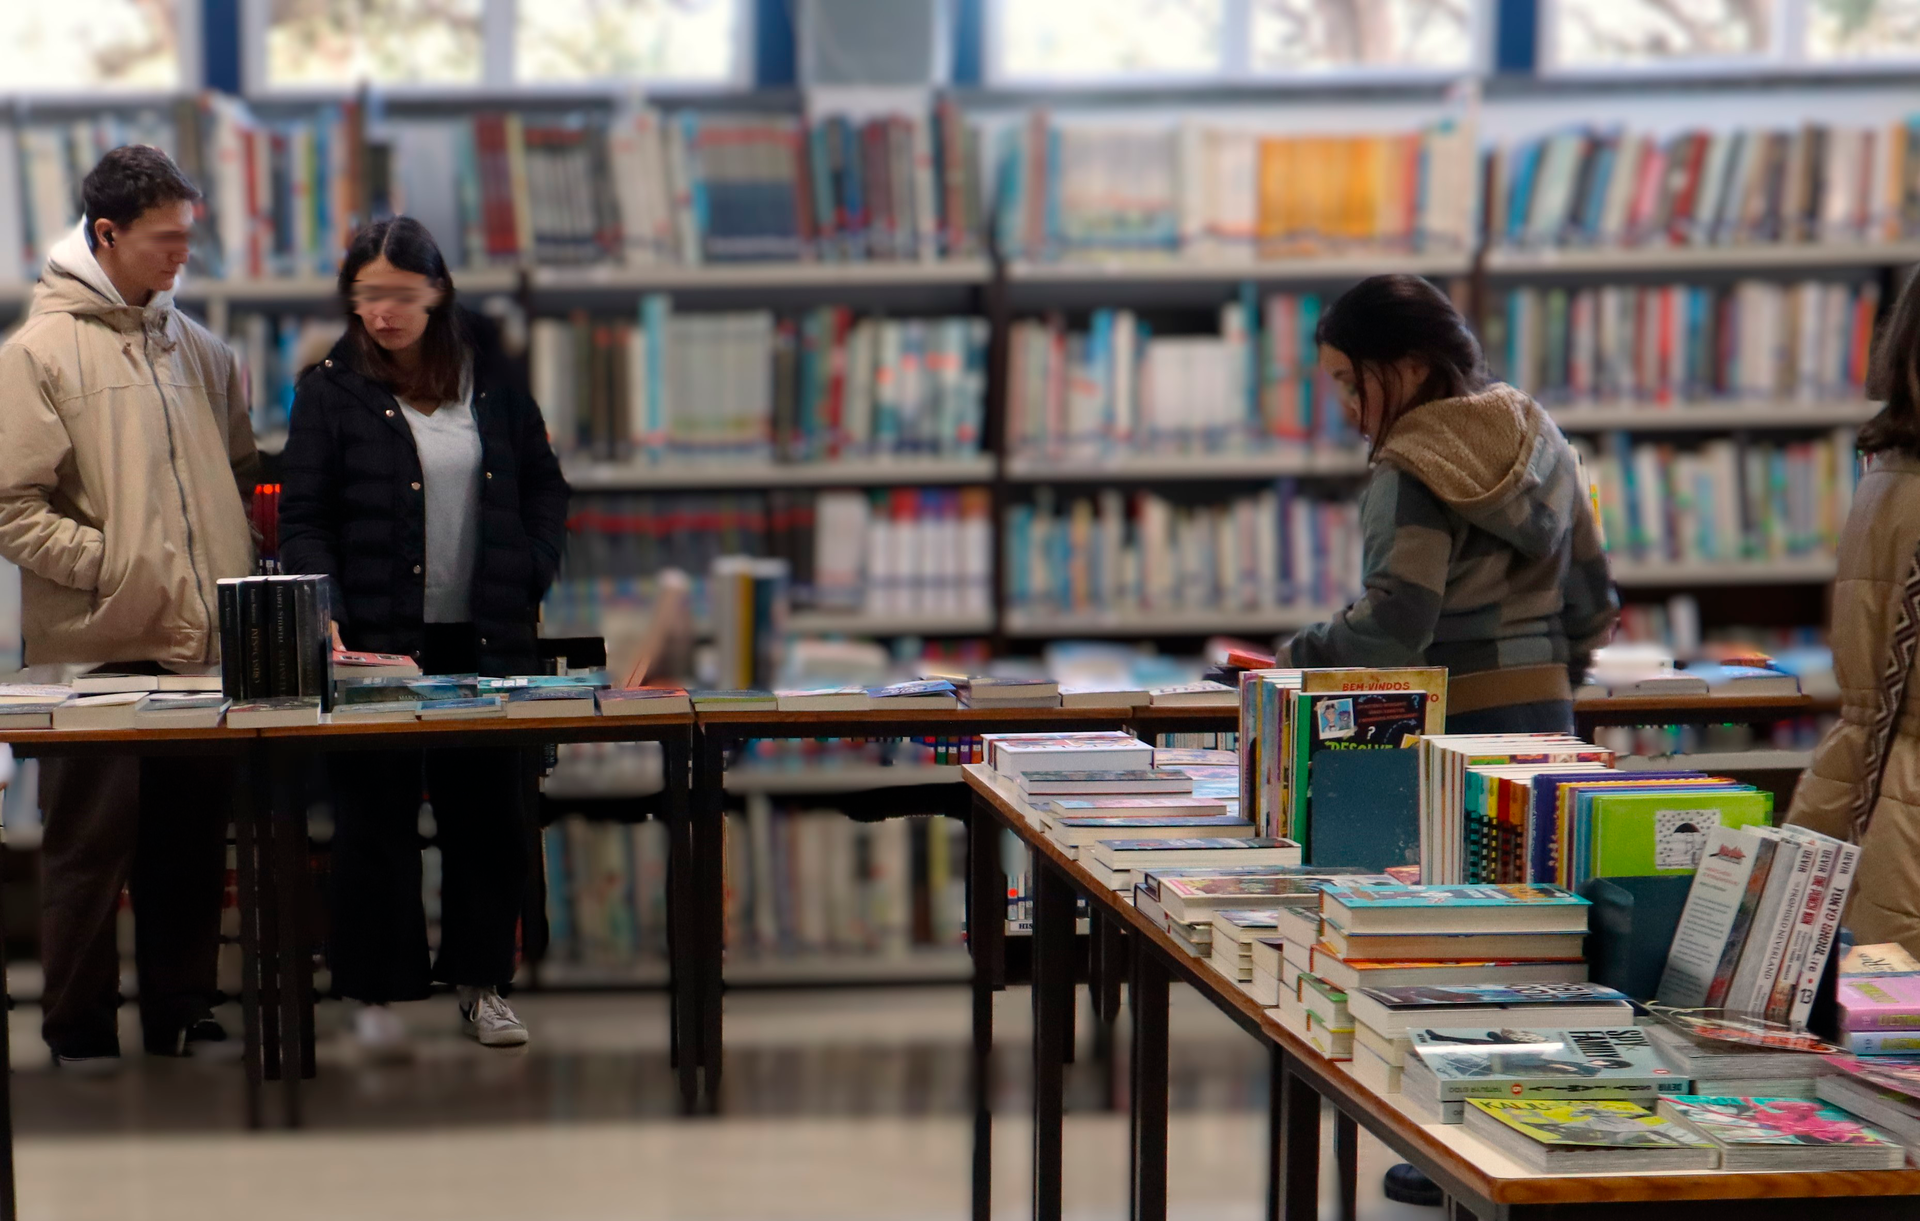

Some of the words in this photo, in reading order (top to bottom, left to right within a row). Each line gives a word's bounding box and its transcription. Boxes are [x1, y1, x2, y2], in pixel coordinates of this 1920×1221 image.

[1797, 849, 1813, 874] DEVIR
[1816, 848, 1832, 873] DEVIR
[1839, 850, 1854, 875] DEVIR
[1825, 886, 1845, 922] TOKYO
[1763, 927, 1786, 980] NEVERLAND
[1799, 988, 1814, 1005] 13
[1568, 1031, 1623, 1058] FAMILY
[1606, 1030, 1651, 1046] SPY
